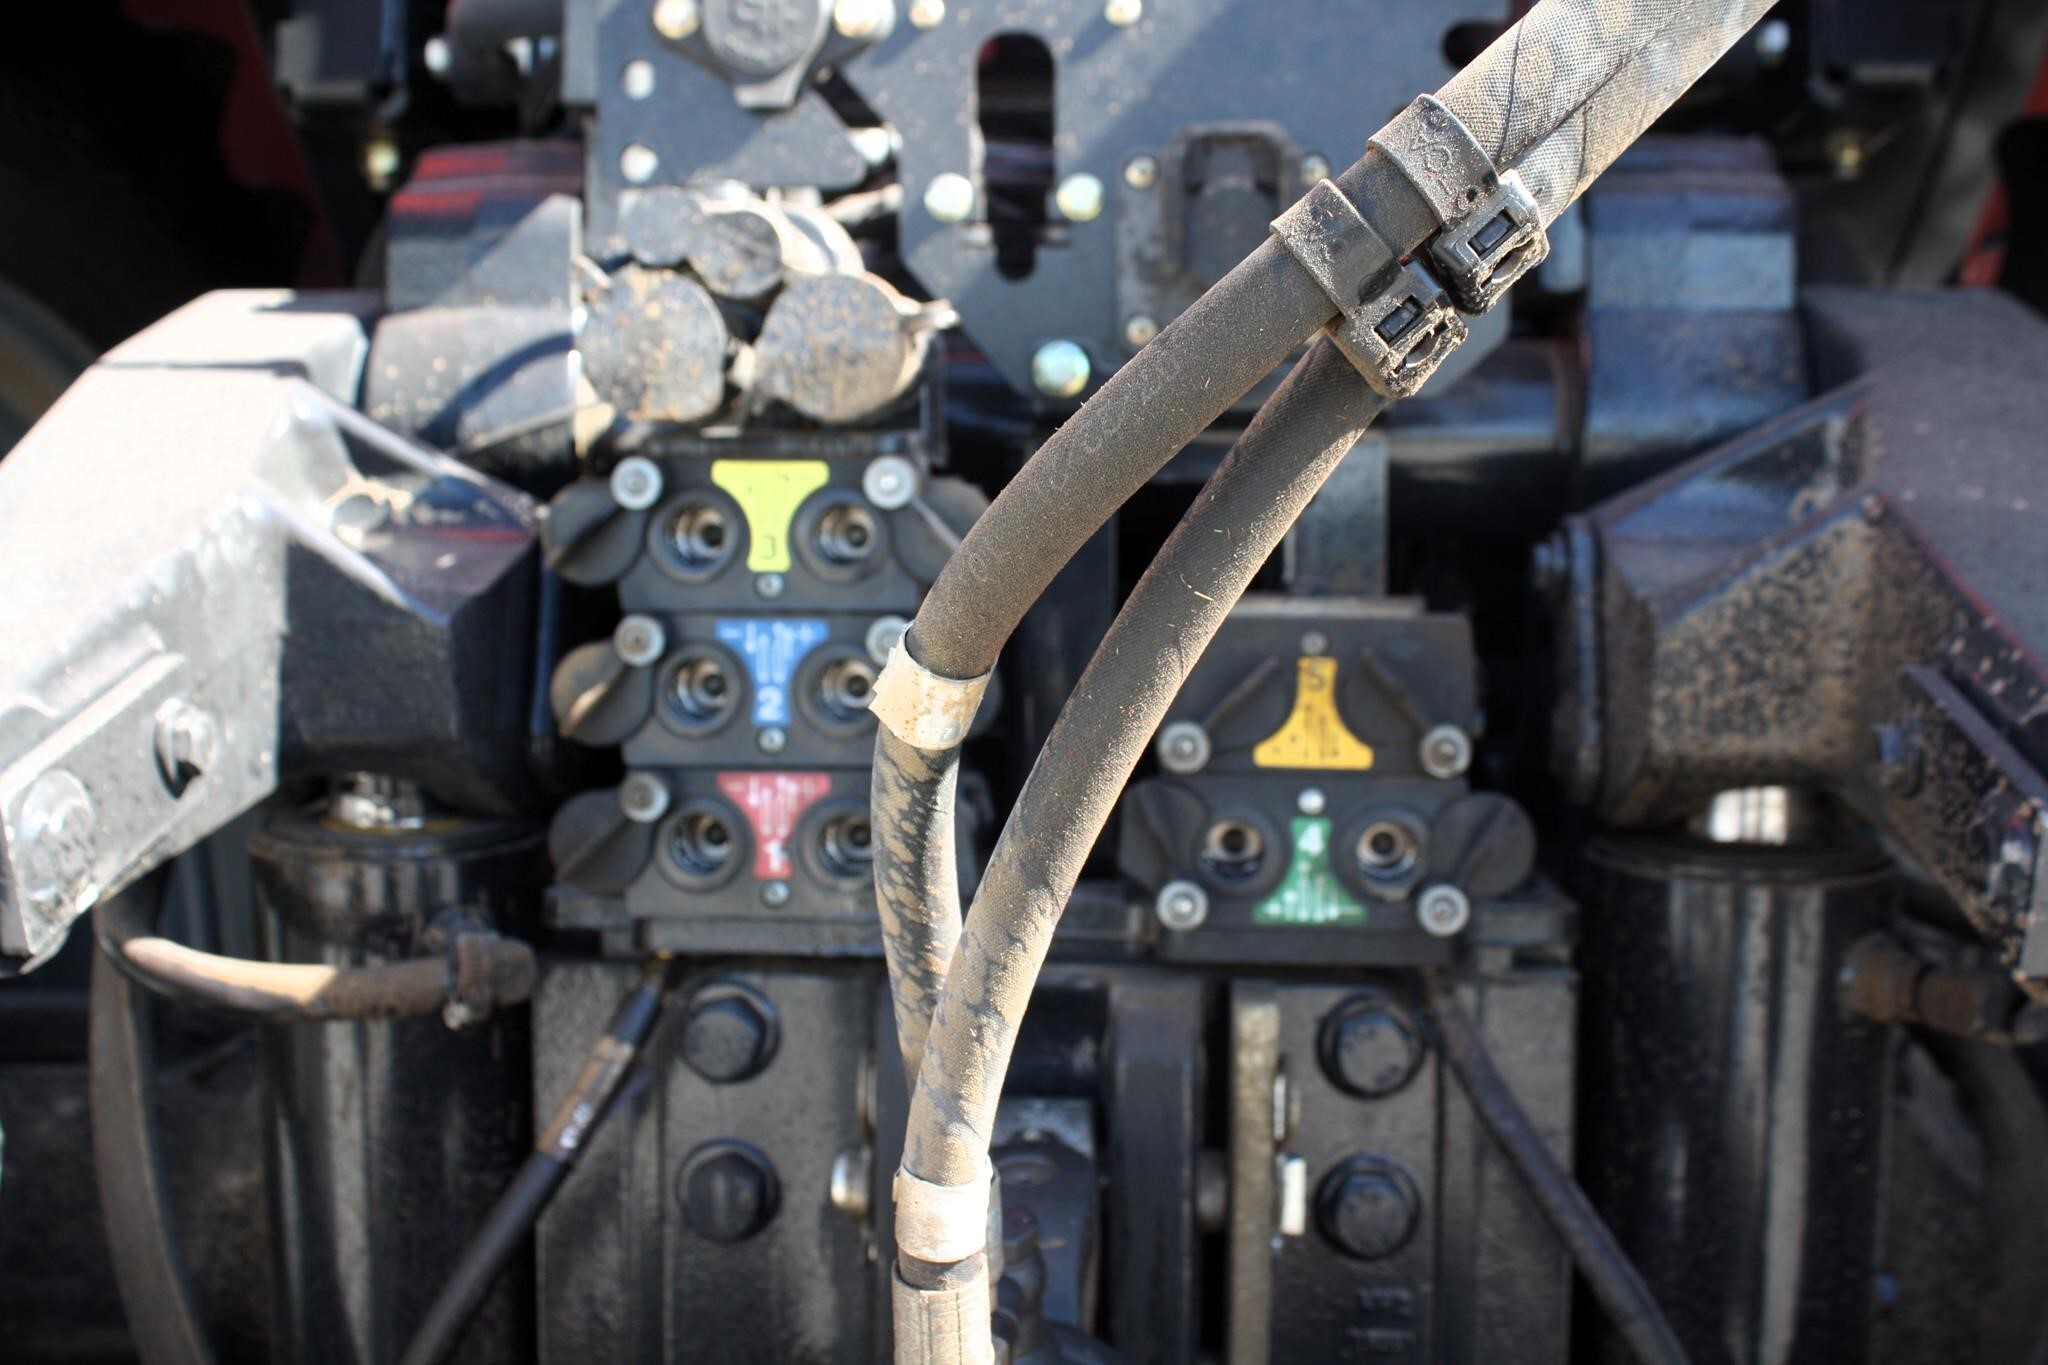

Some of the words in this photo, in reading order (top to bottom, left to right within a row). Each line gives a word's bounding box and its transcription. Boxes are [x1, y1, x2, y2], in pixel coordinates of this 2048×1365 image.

[757, 686, 784, 721] 2
[763, 841, 783, 873] 1
[1298, 823, 1325, 857] 4
